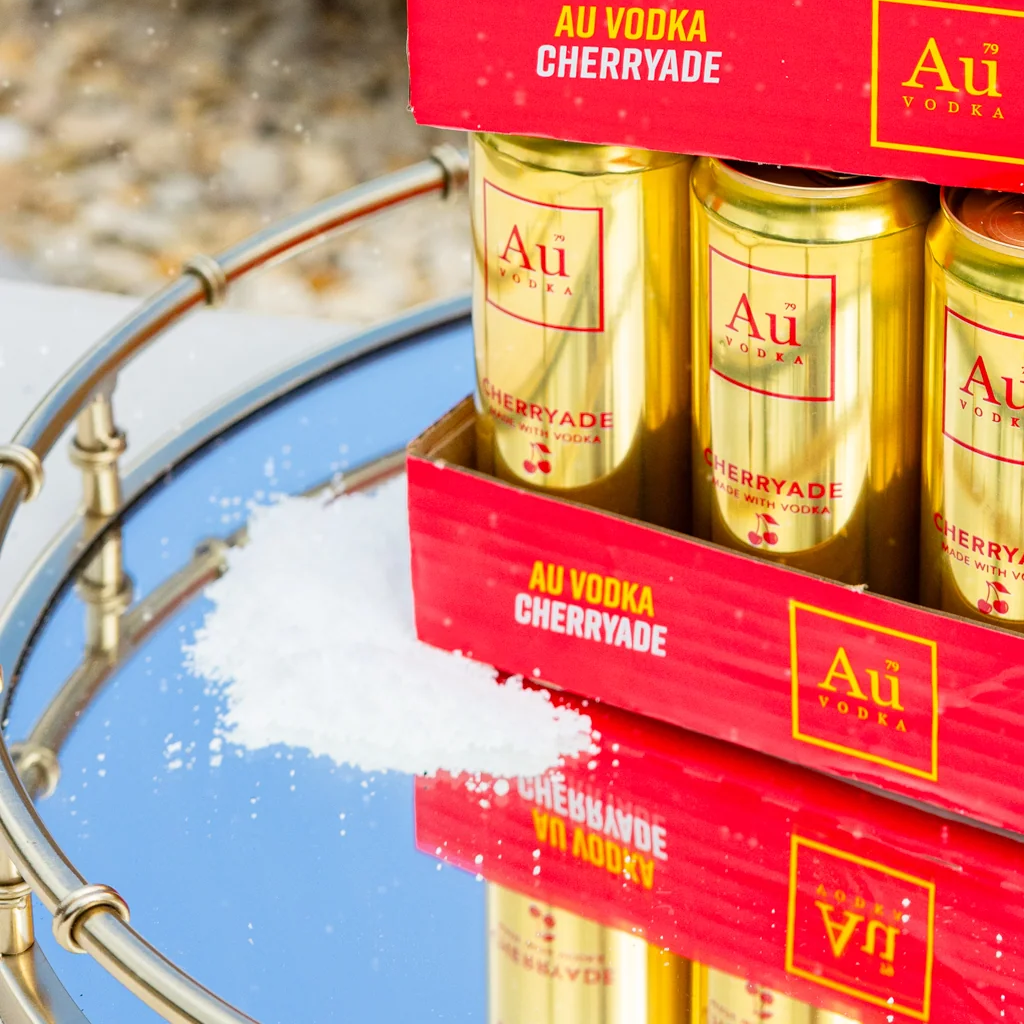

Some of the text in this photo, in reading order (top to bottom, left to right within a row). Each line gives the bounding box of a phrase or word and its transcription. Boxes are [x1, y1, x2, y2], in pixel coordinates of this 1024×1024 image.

[554, 4, 707, 43] AU VODKA
[536, 43, 723, 84] CHERRYADE
[902, 36, 1003, 98] Au
[982, 43, 999, 55] 79
[902, 95, 1005, 120] VODKA
[499, 223, 570, 278] Au
[499, 268, 573, 296] VODKA
[725, 292, 802, 347] Au
[726, 335, 804, 365] VODKA
[481, 376, 614, 430] CHERRYADE
[489, 407, 602, 444] MADE WITH VODKA
[703, 446, 844, 500] CHERRYADE
[712, 475, 831, 516] MADE WITH VODKA
[940, 542, 971, 567] MADE
[974, 559, 1008, 578] WITH
[528, 560, 655, 618] AU VODKA
[514, 592, 668, 658] CHERRYADE
[817, 646, 905, 712] Au
[885, 659, 900, 672] 79
[817, 695, 908, 733] VODKA
